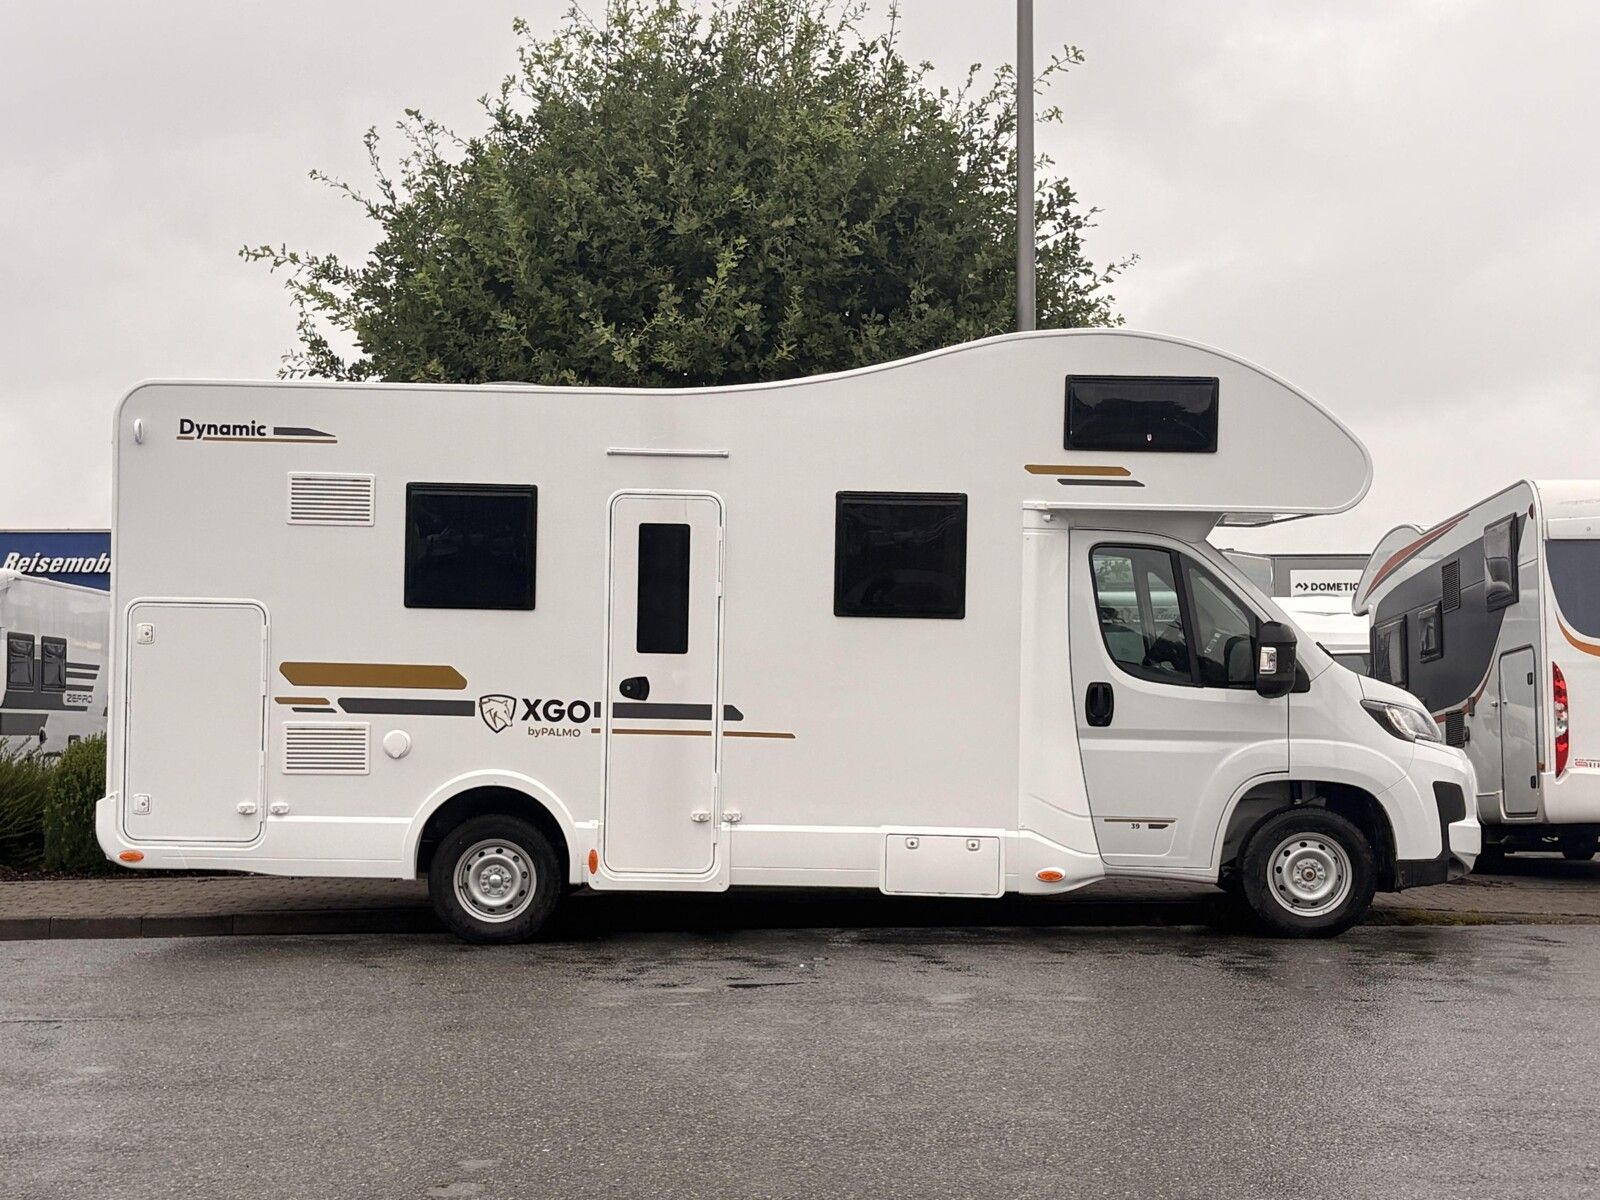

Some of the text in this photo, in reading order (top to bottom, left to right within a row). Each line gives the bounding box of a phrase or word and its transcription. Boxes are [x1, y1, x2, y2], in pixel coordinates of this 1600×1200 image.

[179, 418, 267, 439] Dynamic
[3, 552, 110, 573] Reisemob
[1310, 582, 1359, 592] DOMETIC
[521, 698, 591, 723] XGO
[527, 726, 581, 738] byPALMO
